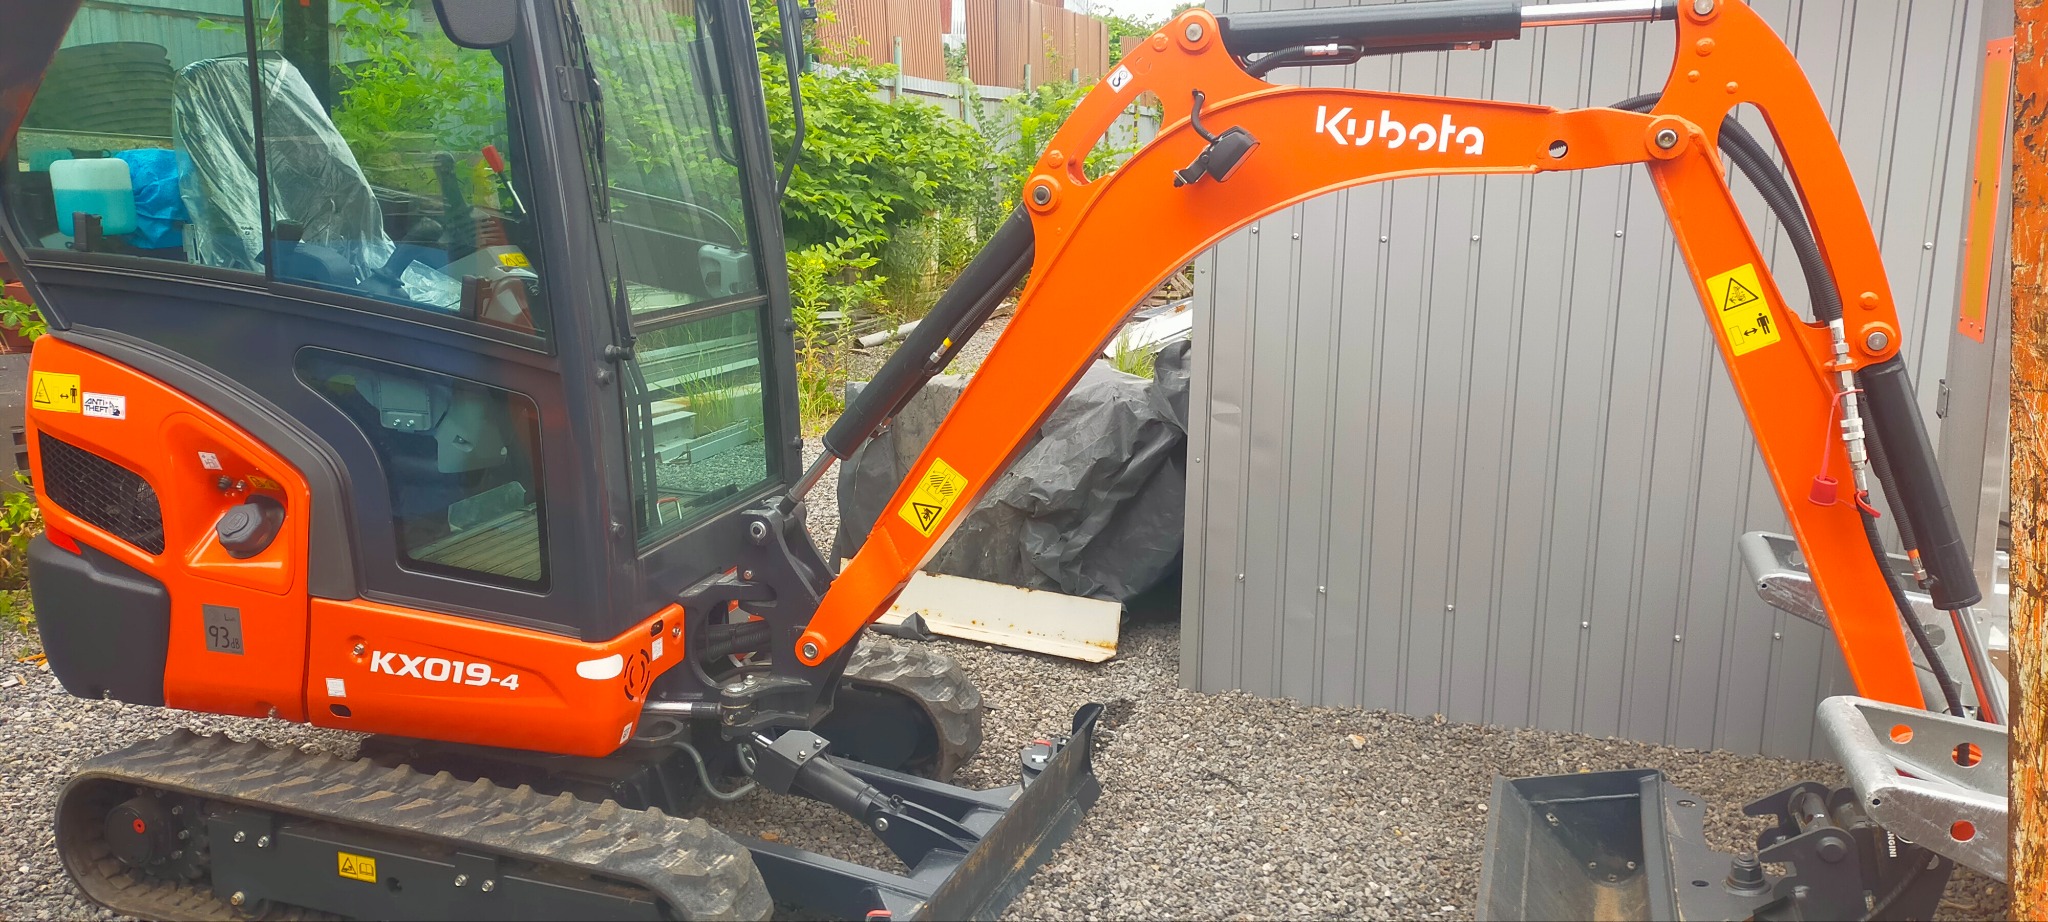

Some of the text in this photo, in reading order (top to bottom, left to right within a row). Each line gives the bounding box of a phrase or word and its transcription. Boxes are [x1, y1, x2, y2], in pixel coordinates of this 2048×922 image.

[1316, 105, 1485, 155] Kubota
[84, 404, 109, 413] THEFT
[370, 650, 520, 691] KX019-4
[1887, 830, 1897, 858] NGINI
